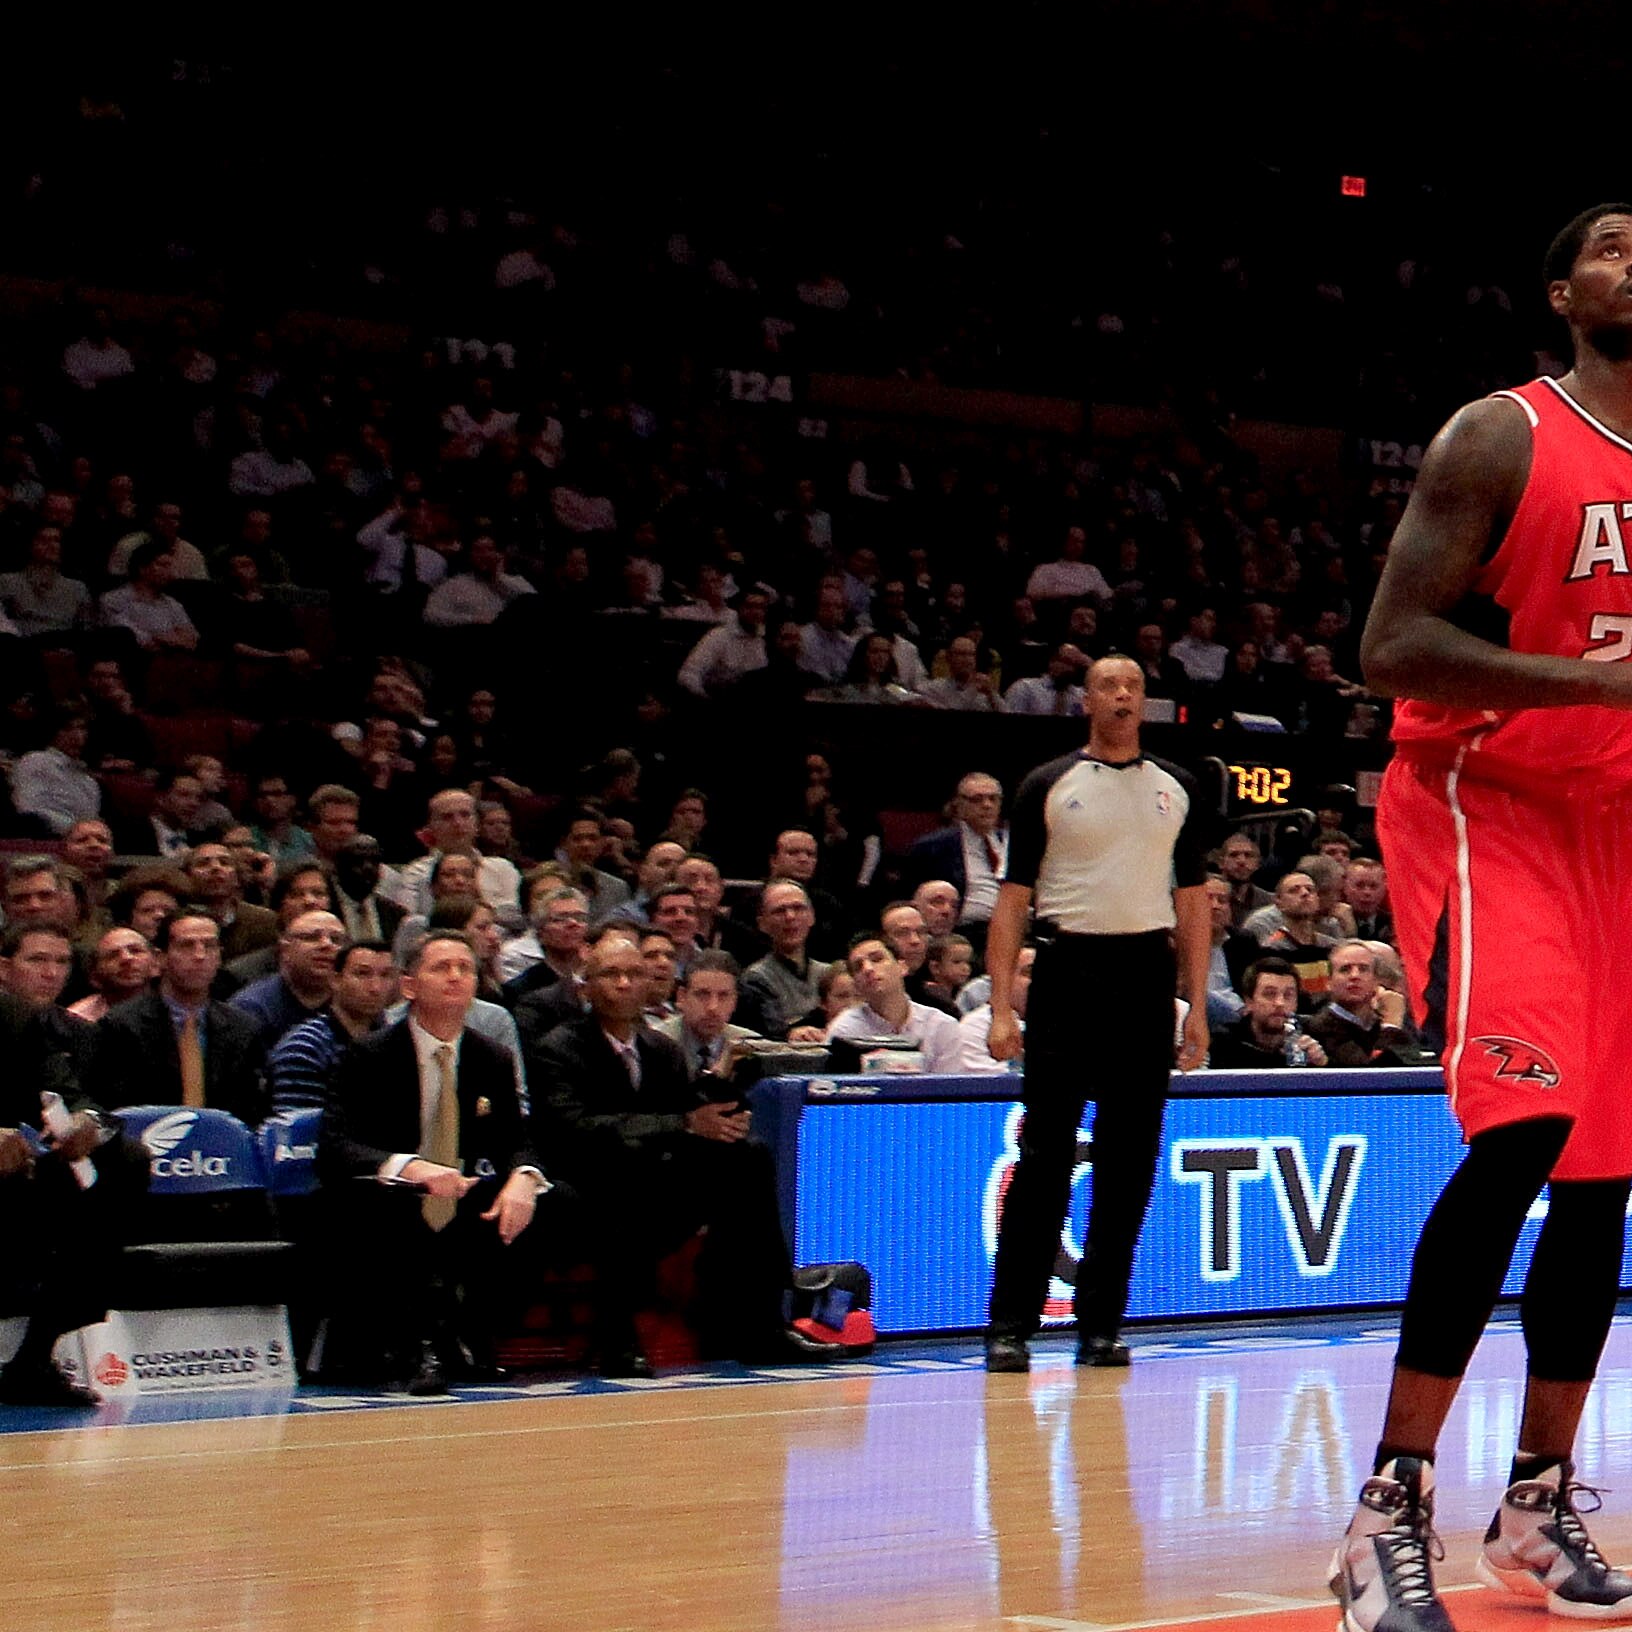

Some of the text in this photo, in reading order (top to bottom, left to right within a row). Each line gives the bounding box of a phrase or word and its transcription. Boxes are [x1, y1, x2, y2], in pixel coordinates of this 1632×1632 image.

[1228, 765, 1291, 804] 7:02
[1169, 1135, 1367, 1280] TV
[132, 1348, 240, 1367] CUSHMAN
[132, 1359, 256, 1380] WAKEFIELD
